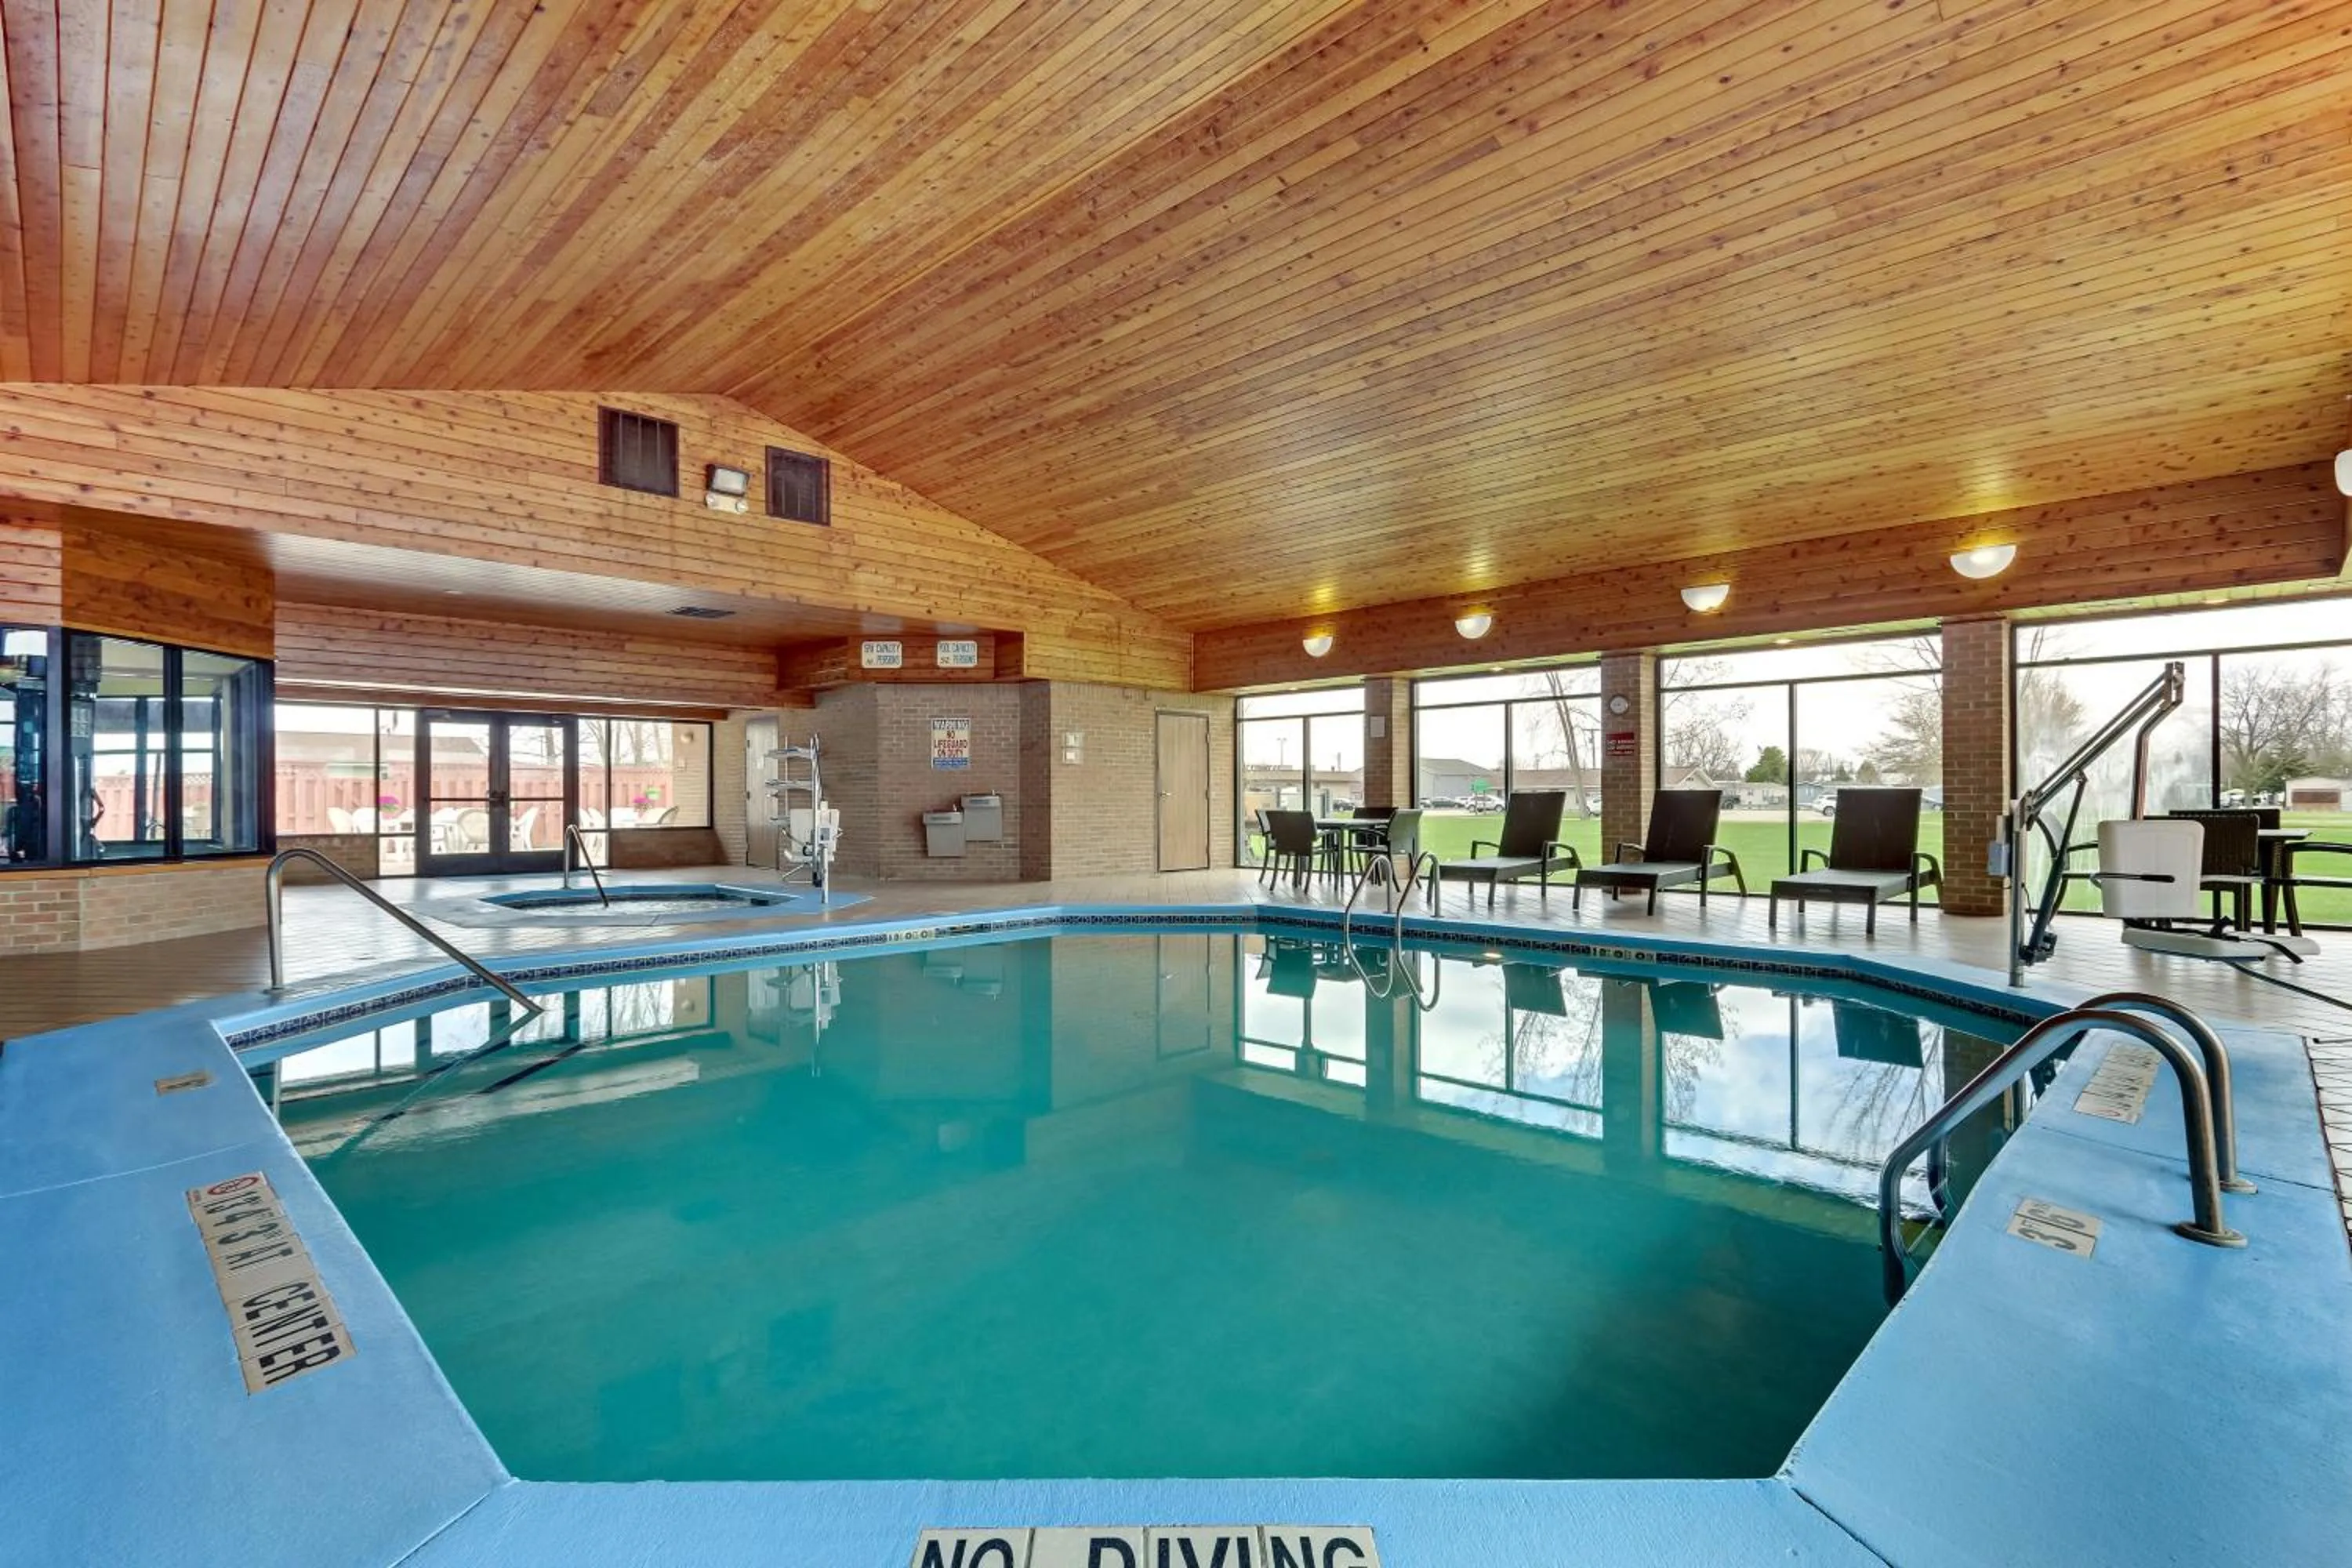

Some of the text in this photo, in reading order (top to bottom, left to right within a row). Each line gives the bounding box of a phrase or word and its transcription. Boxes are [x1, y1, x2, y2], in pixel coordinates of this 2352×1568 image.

[933, 720, 969, 730] WARNING
[934, 739, 968, 749] LIFEGUARD
[226, 1241, 294, 1271] AT
[242, 1281, 341, 1385] CENTER
